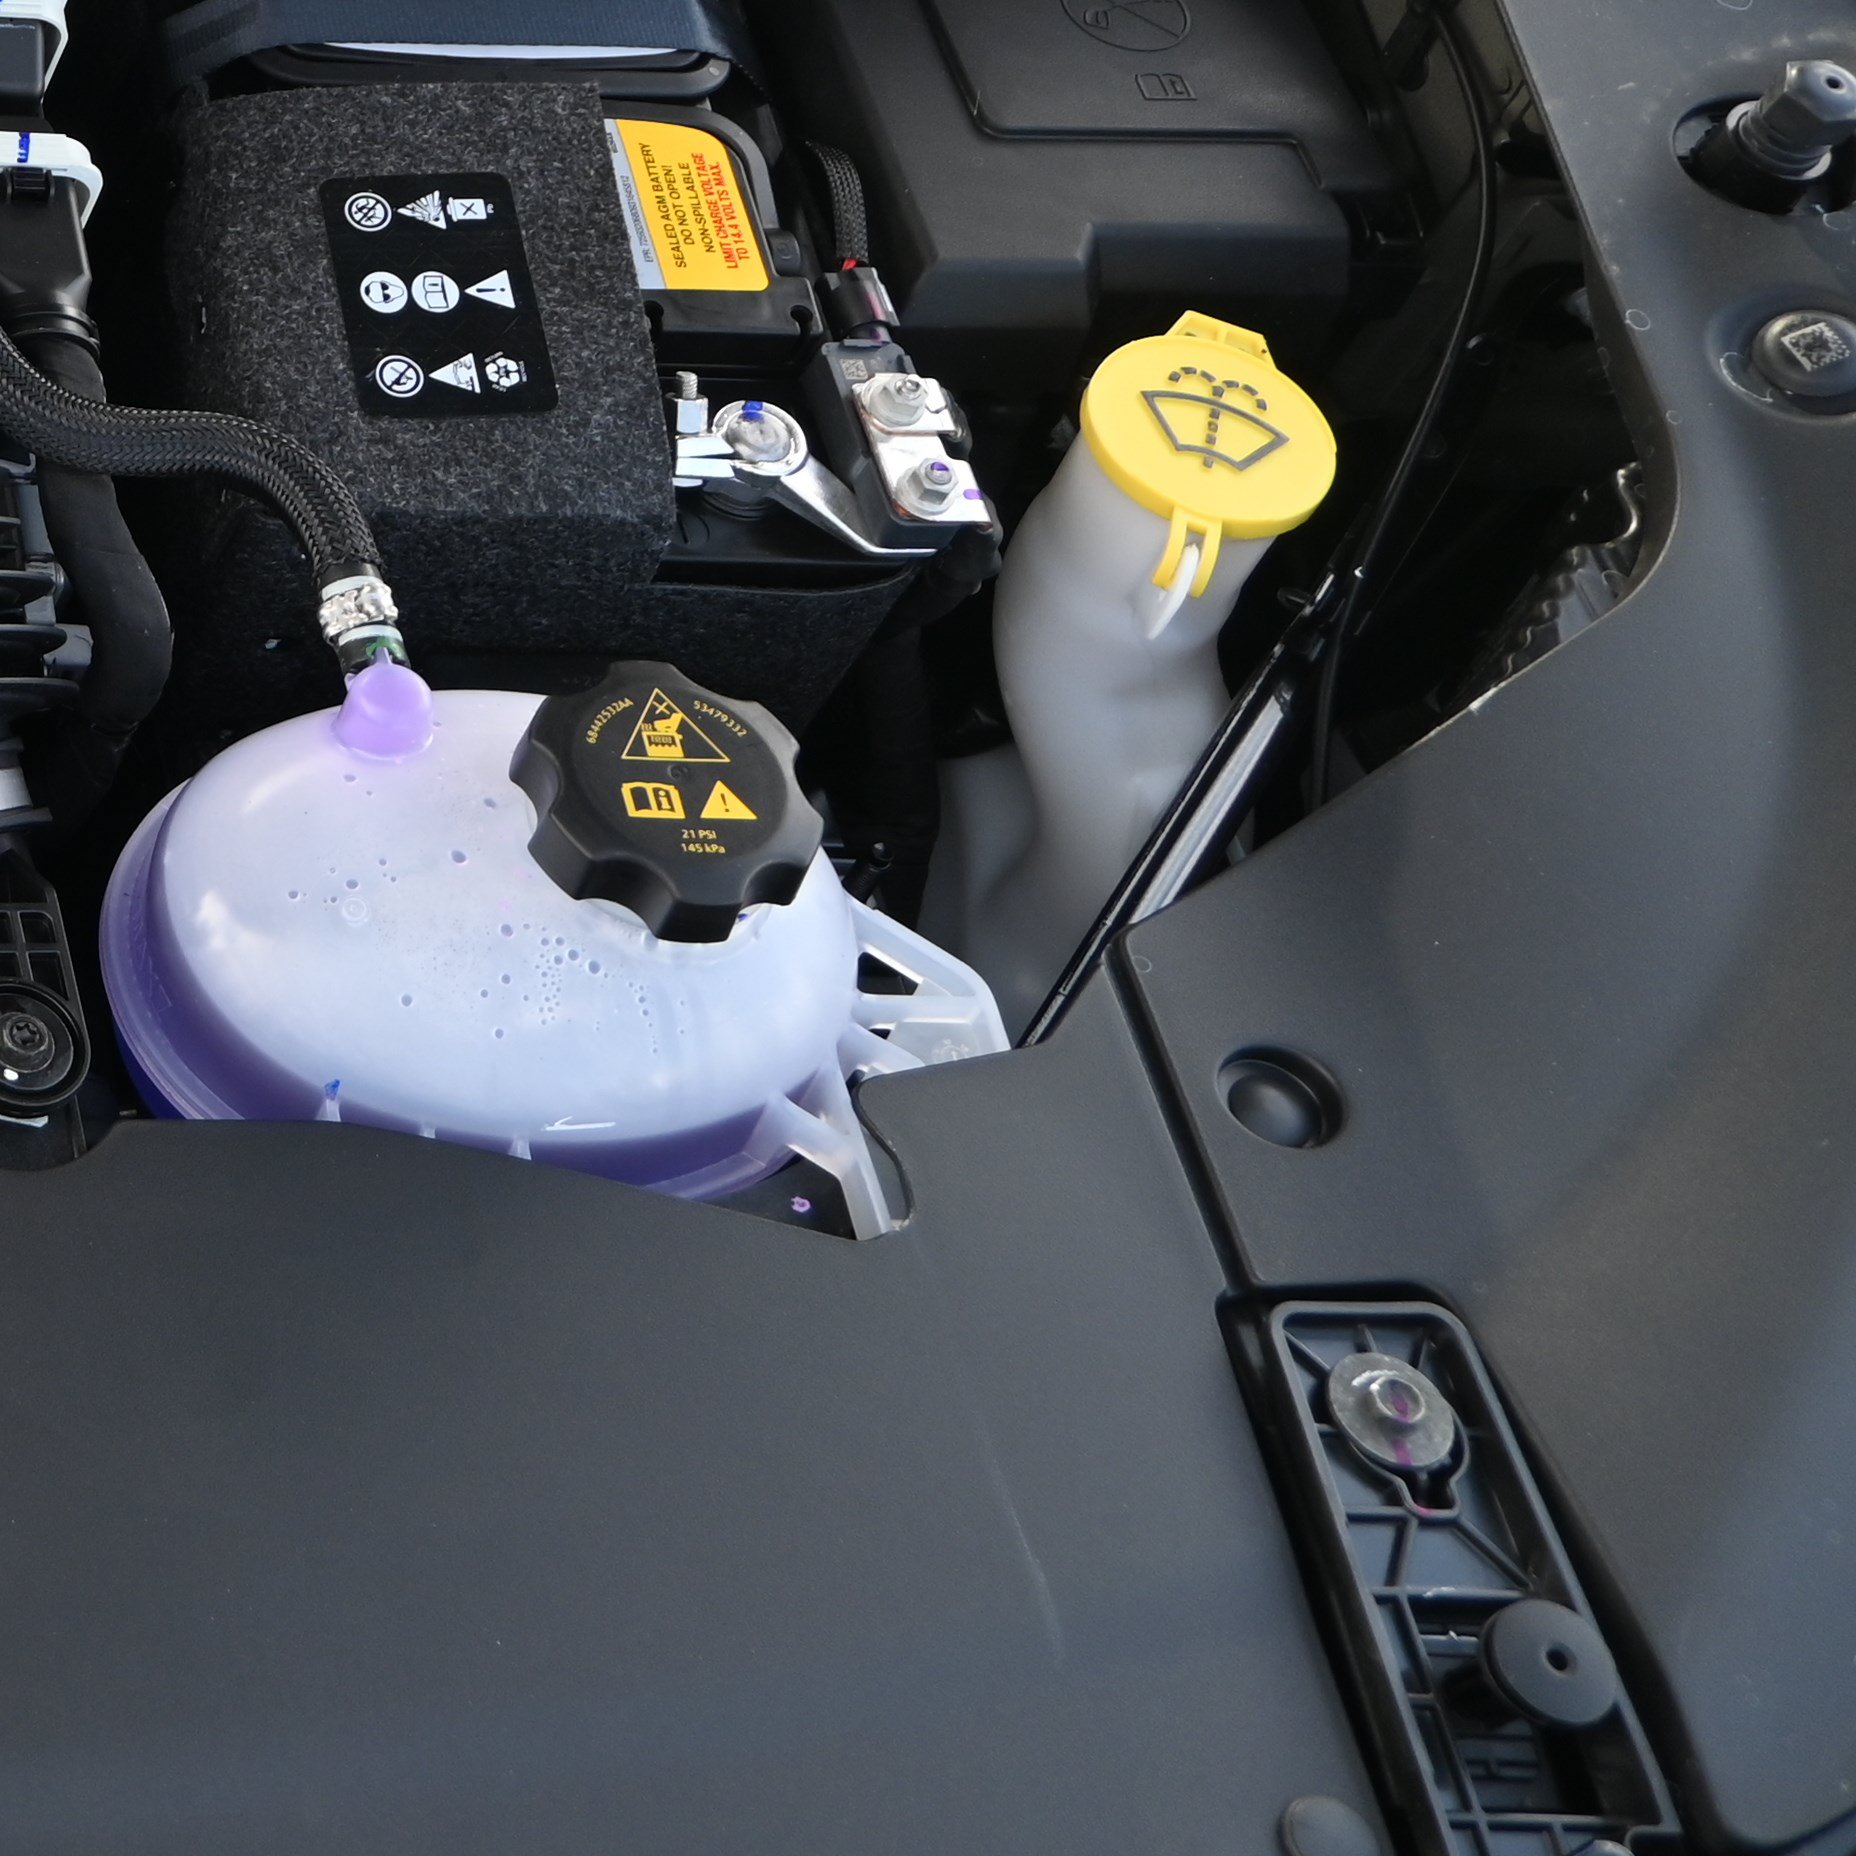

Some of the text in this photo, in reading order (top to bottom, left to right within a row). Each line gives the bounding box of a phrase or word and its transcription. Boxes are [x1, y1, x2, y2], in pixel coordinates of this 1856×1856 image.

[639, 143, 686, 268] SEALED AGM BATTERY
[662, 164, 694, 245] DO NOT OPEN!
[678, 162, 716, 253] NON-SPILLABLE
[691, 152, 738, 269] LIMIT CHARGE VOLTAGE
[717, 190, 738, 223] VOLTS
[736, 247, 750, 260] TO
[693, 699, 749, 739] 53479332
[681, 828, 717, 841] 21 PSI
[681, 842, 726, 856] 145 kPa
